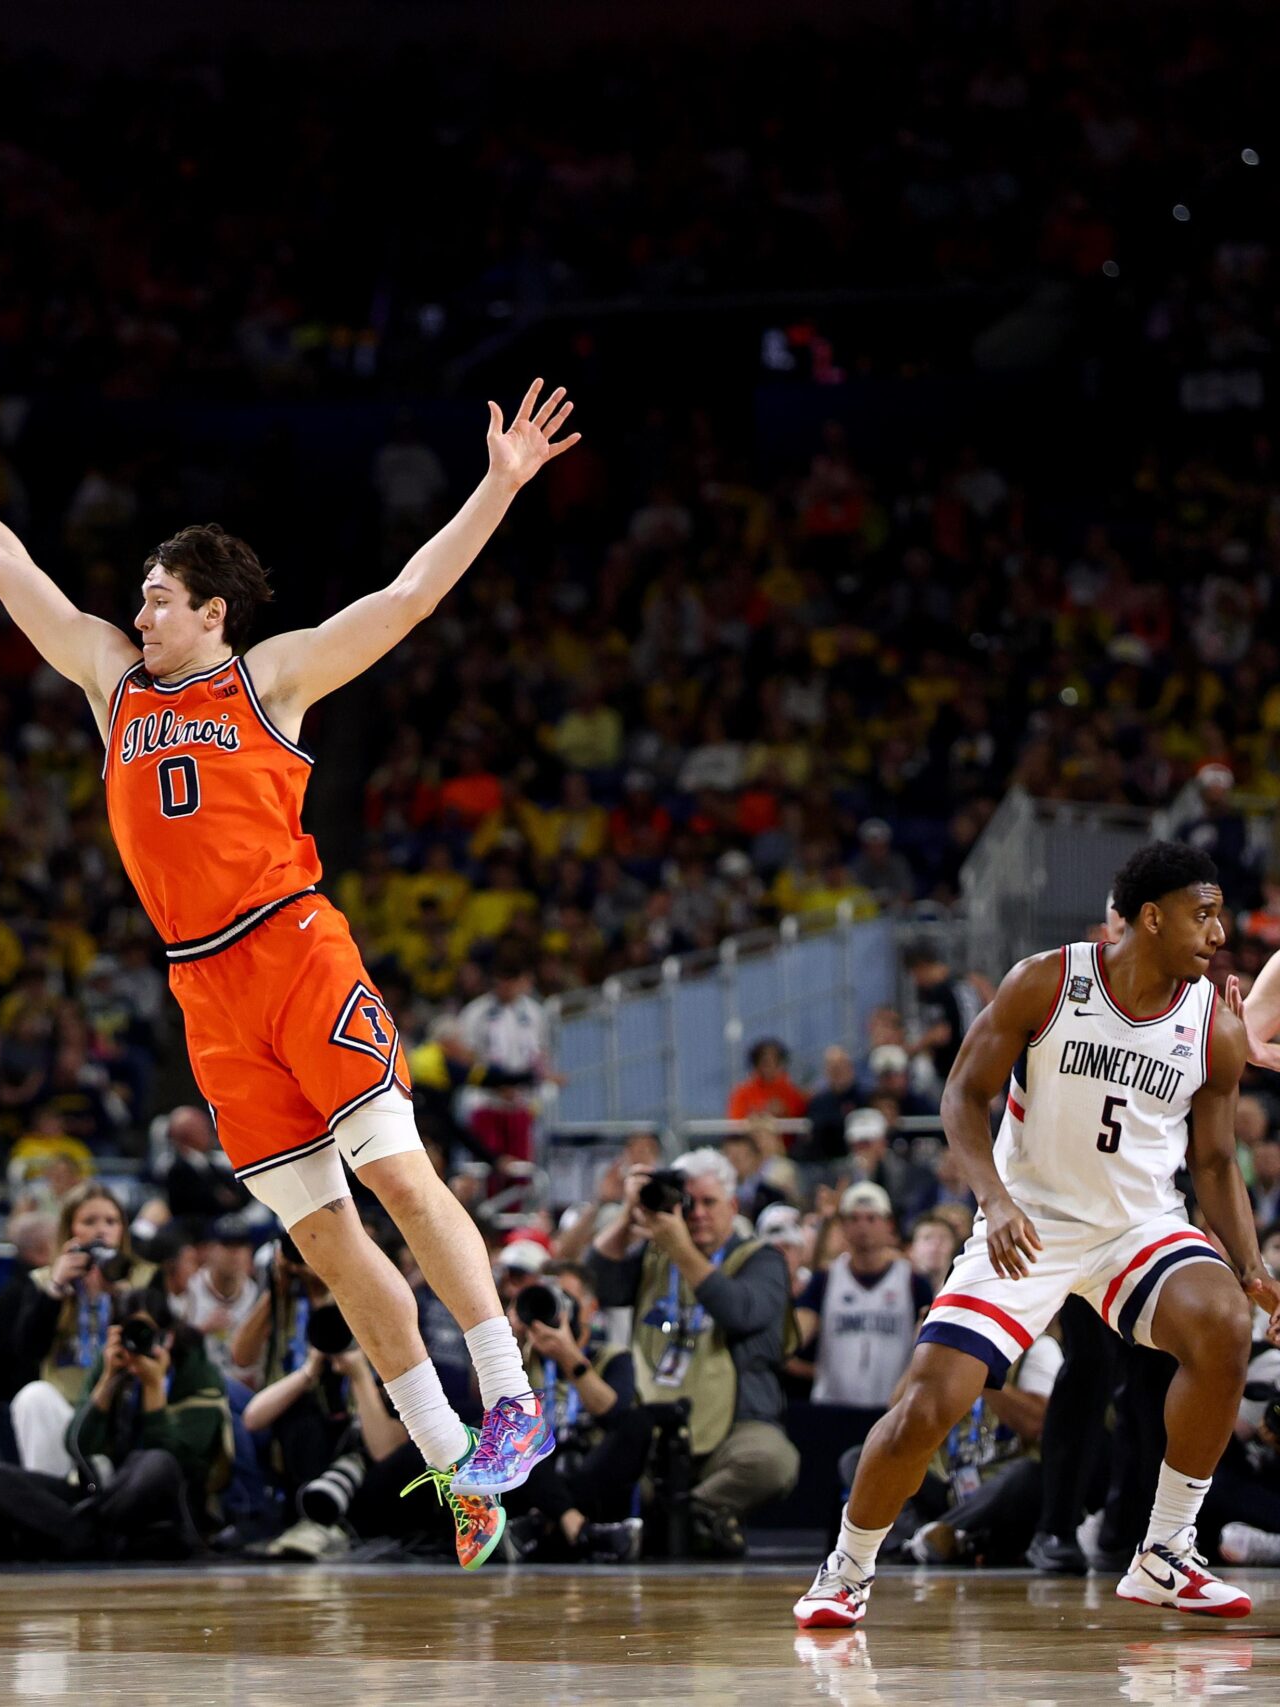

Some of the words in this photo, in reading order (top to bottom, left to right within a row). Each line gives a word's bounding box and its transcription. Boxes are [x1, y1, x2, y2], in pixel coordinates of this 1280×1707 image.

[121, 709, 241, 764] Illinois
[157, 754, 201, 820] 0
[1059, 1040, 1185, 1104] CONNECTICUT
[1096, 1095, 1128, 1154] 5
